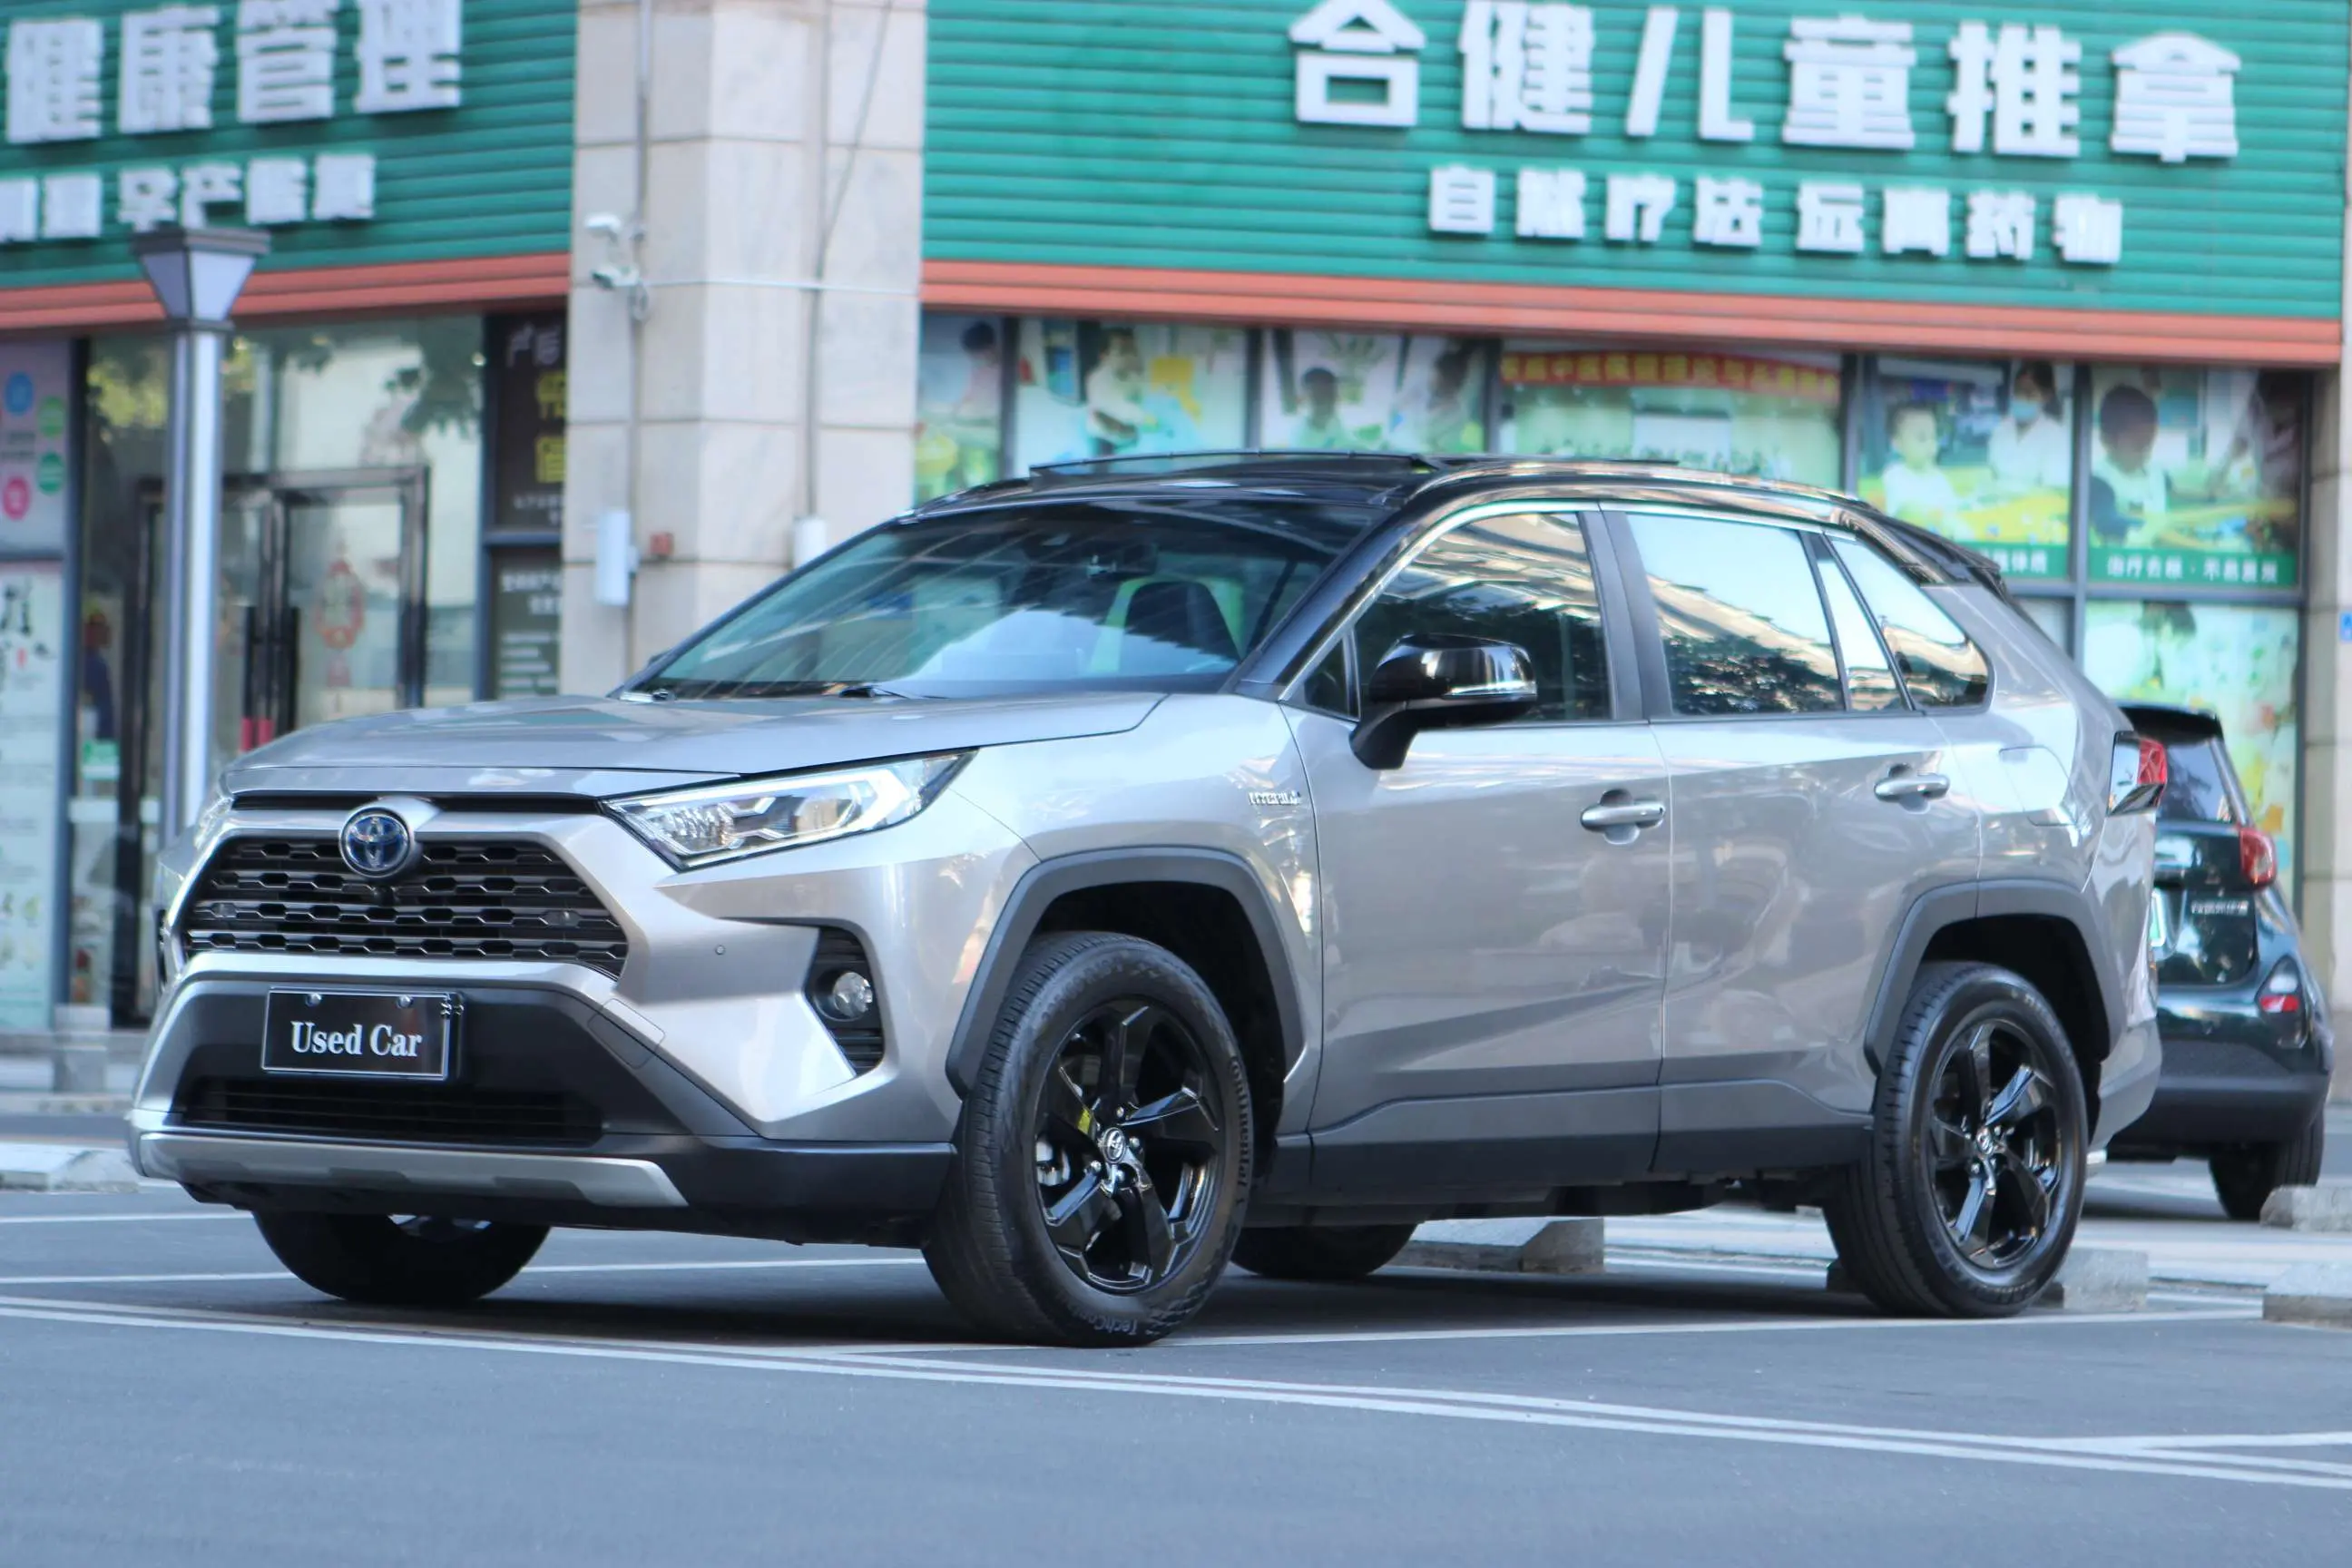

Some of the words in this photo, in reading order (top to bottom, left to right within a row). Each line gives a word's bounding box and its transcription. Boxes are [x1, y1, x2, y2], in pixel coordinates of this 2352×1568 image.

[7, 0, 463, 143] 健康管理
[1289, 0, 2241, 163] 合健儿童推拿
[290, 1021, 363, 1055] Used
[370, 1024, 422, 1057] Car
[1230, 1055, 1250, 1187] Continental
